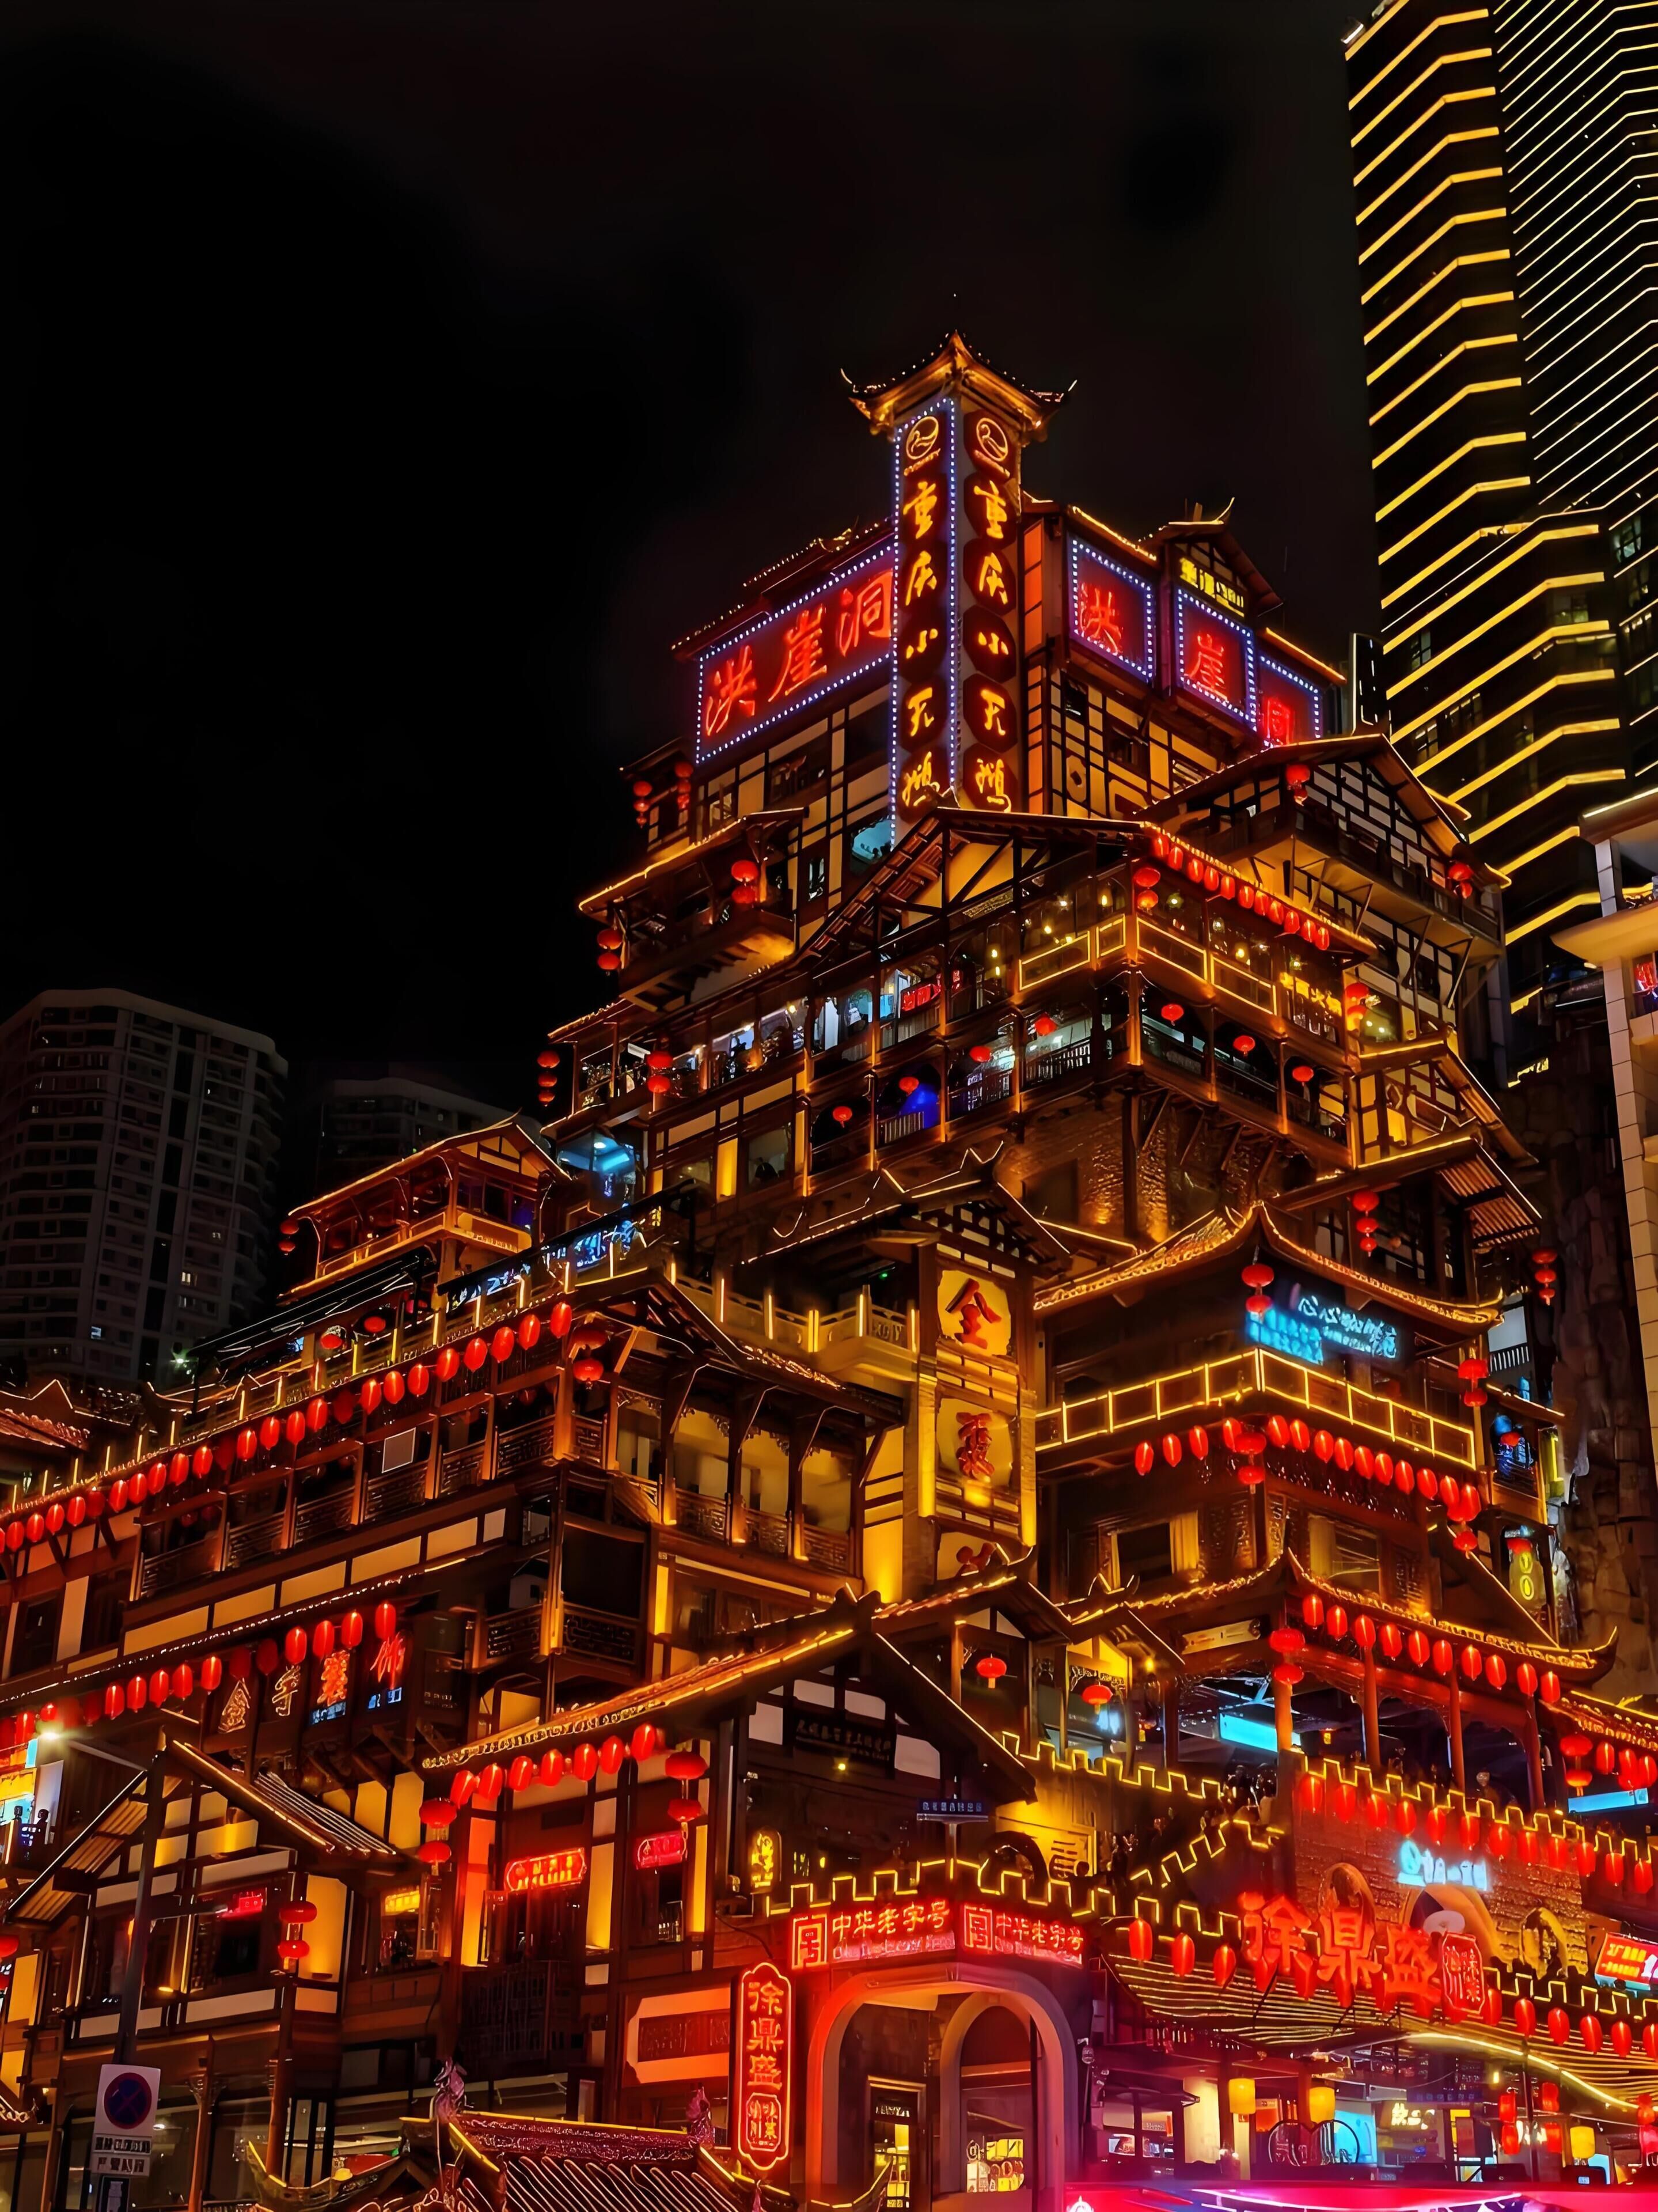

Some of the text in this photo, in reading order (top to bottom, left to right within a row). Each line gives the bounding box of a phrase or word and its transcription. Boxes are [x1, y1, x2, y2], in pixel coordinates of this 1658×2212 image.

[705, 567, 893, 737] 洪崖洞
[832, 1899, 950, 1942] 中华老字号
[1238, 1890, 1443, 2005] 徐鼎盛
[746, 1979, 785, 2091] 徐鼎盛
